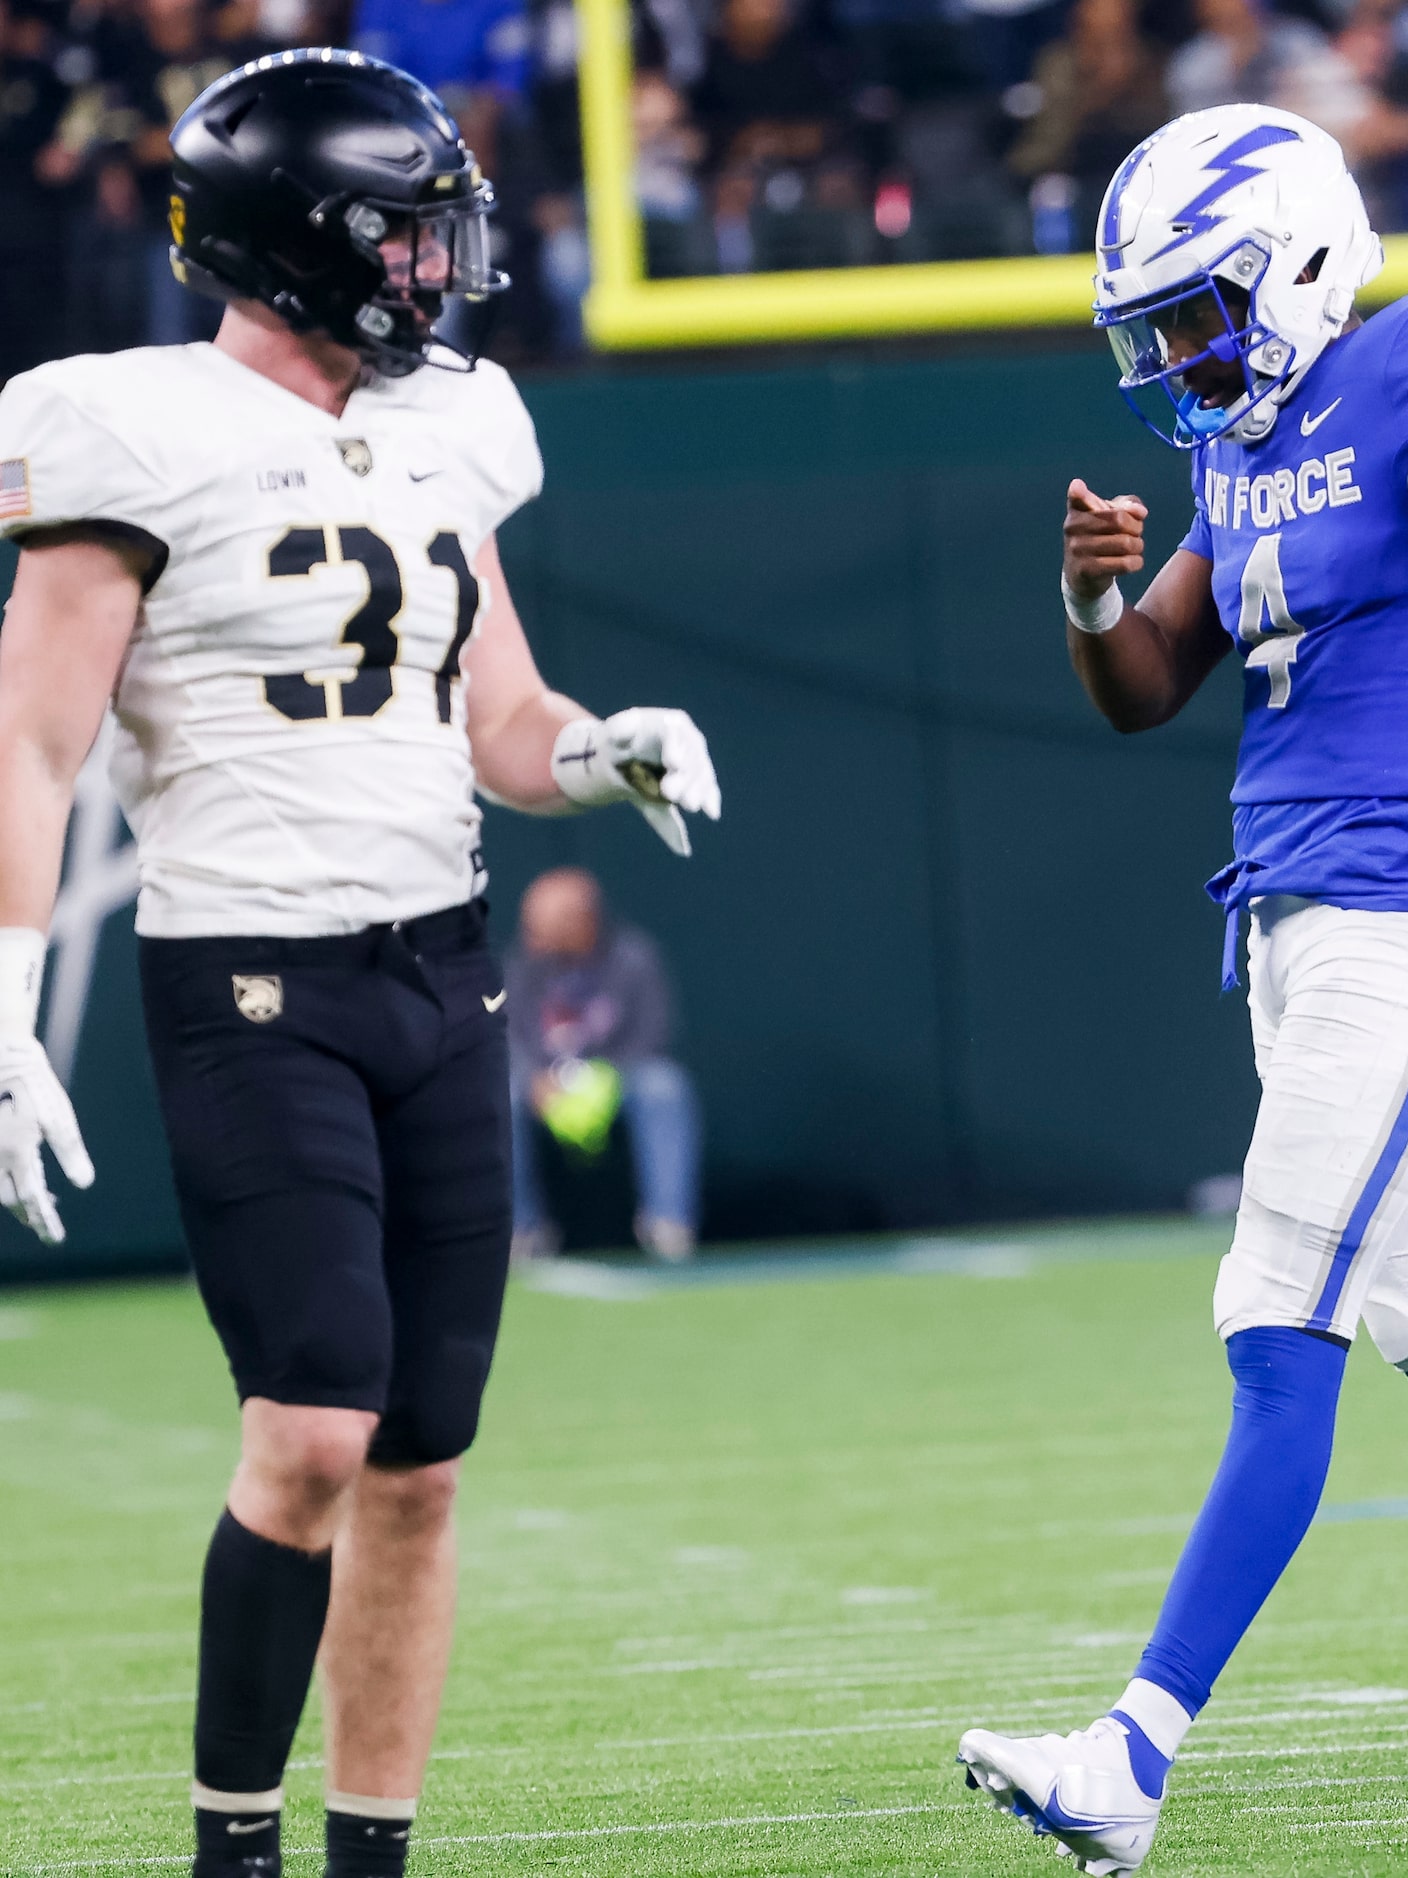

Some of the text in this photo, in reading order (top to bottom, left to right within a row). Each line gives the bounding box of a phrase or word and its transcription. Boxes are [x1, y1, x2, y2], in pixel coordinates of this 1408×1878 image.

[256, 469, 307, 492] LOWIN
[1232, 446, 1363, 531] FORCE
[262, 522, 478, 726] 31
[1238, 531, 1308, 708] 4
